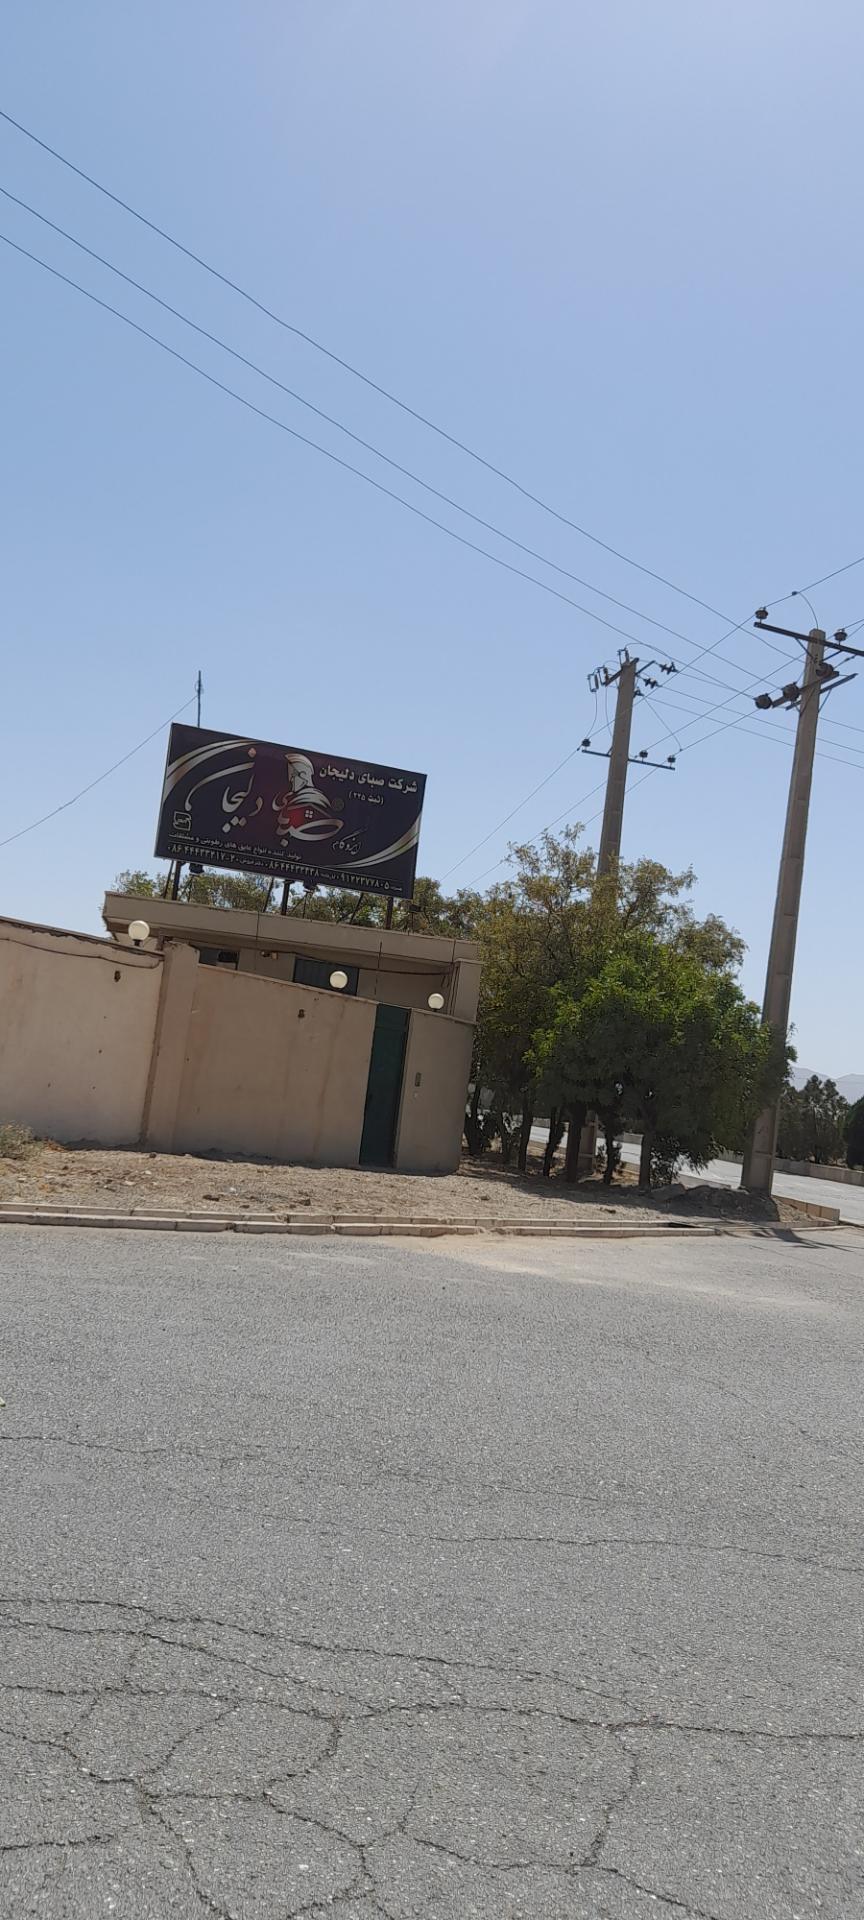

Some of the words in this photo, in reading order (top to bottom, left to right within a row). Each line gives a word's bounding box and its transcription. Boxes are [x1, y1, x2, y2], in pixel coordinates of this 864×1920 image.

[319, 764, 354, 781] دلیجان
[357, 772, 385, 788] صبای
[184, 747, 263, 832] دلیجان
[388, 778, 417, 793] شرکت
[200, 837, 223, 847] رطوبتی
